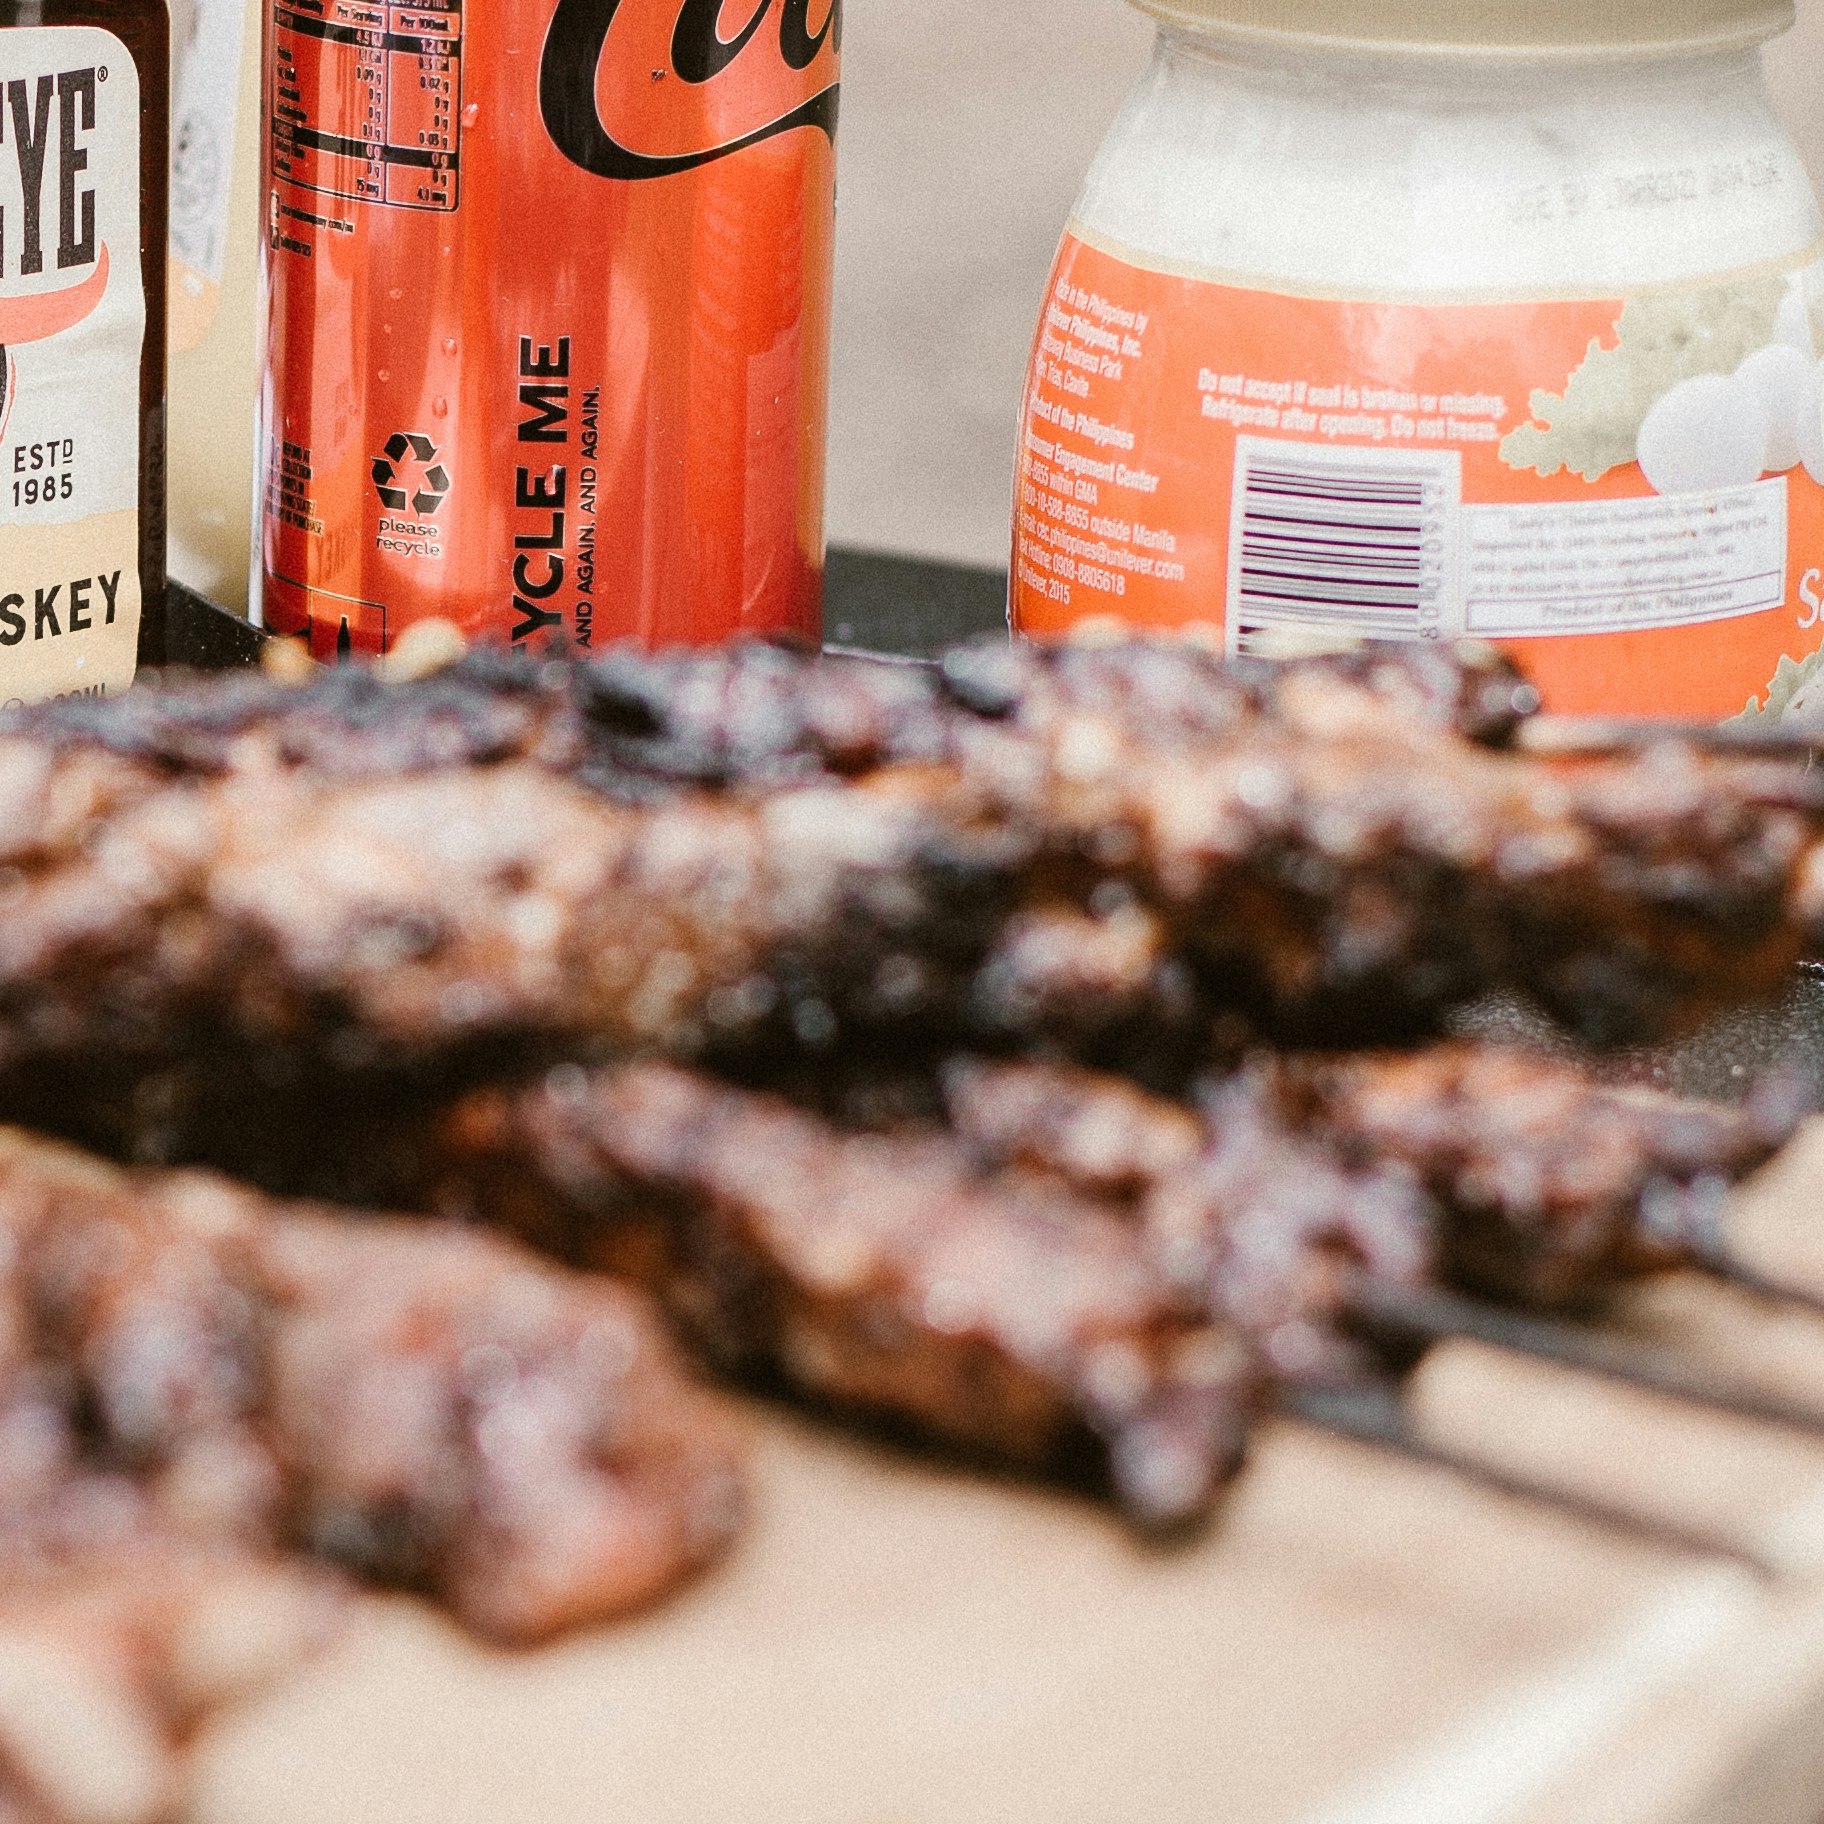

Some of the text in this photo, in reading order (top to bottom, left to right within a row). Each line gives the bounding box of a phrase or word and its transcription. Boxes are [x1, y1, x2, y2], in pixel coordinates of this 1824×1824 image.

[1121, 334, 1143, 358] Inc.
[1099, 355, 1124, 381] Park
[1198, 367, 1217, 392] Do
[1075, 413, 1136, 450] Philippines
[1054, 443, 1116, 483] Engagement
[1115, 464, 1160, 494] Center
[12, 472, 74, 507] 1985
[511, 333, 571, 656] YCLE ME
[379, 517, 438, 538] please
[575, 384, 601, 649] AND AGAIN. AND AGAIN.
[376, 536, 440, 556] recycle
[1090, 516, 1131, 542] outside
[1132, 523, 1177, 554] Manila
[1048, 579, 1071, 605] 2015
